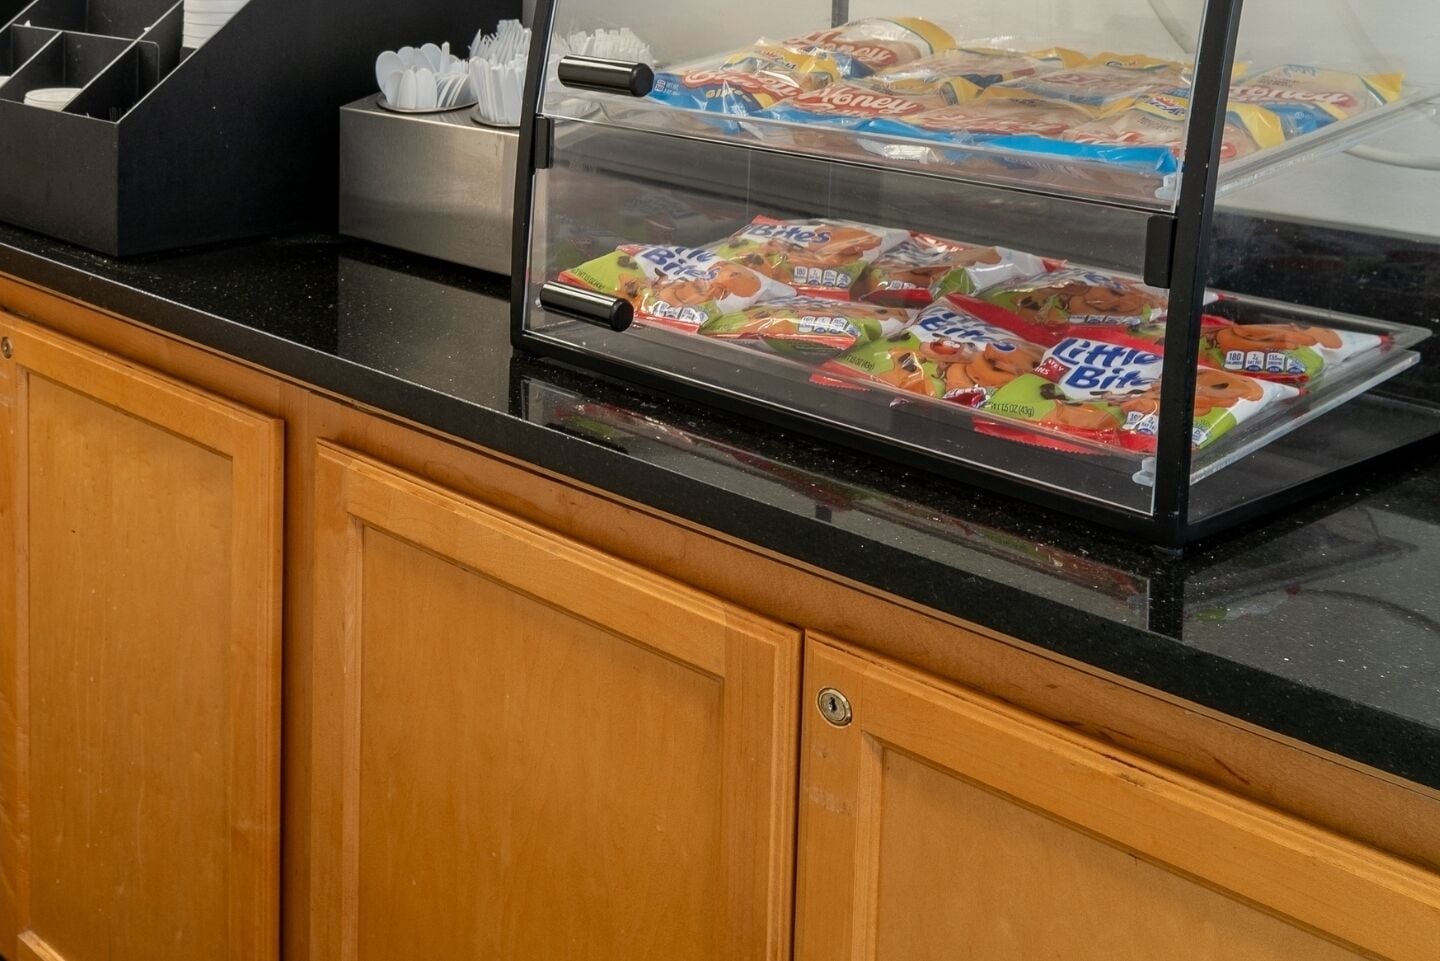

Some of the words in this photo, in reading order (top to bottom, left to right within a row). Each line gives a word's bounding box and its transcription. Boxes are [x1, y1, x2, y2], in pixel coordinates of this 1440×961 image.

[1052, 338, 1164, 368] Little
[1229, 352, 1242, 361] 180
[1018, 405, 1035, 418] (43g)
